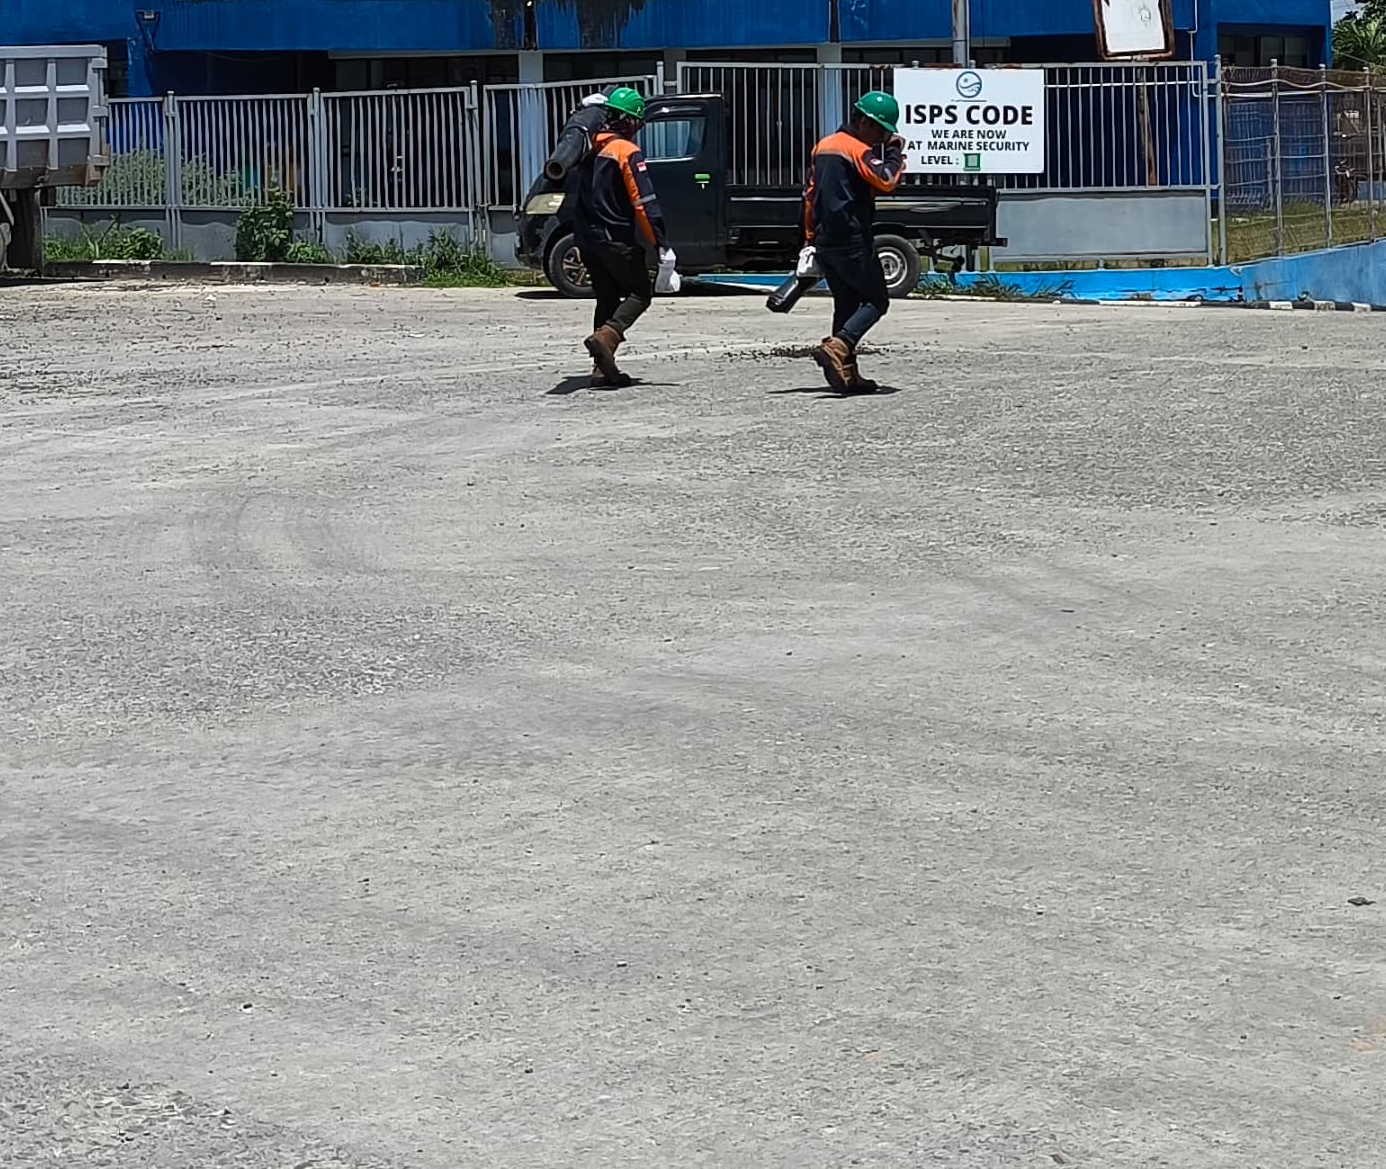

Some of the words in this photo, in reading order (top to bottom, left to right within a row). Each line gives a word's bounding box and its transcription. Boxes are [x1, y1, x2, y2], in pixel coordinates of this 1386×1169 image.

[905, 104, 958, 125] ISPS
[966, 105, 1033, 125] CODE
[931, 130, 949, 139] WE
[952, 130, 974, 139] ARE
[977, 130, 1007, 139] NOW
[907, 141, 923, 151] AT
[927, 141, 974, 151] MARINE
[976, 141, 1030, 151] SECURITY
[921, 155, 953, 165] LEVEL
